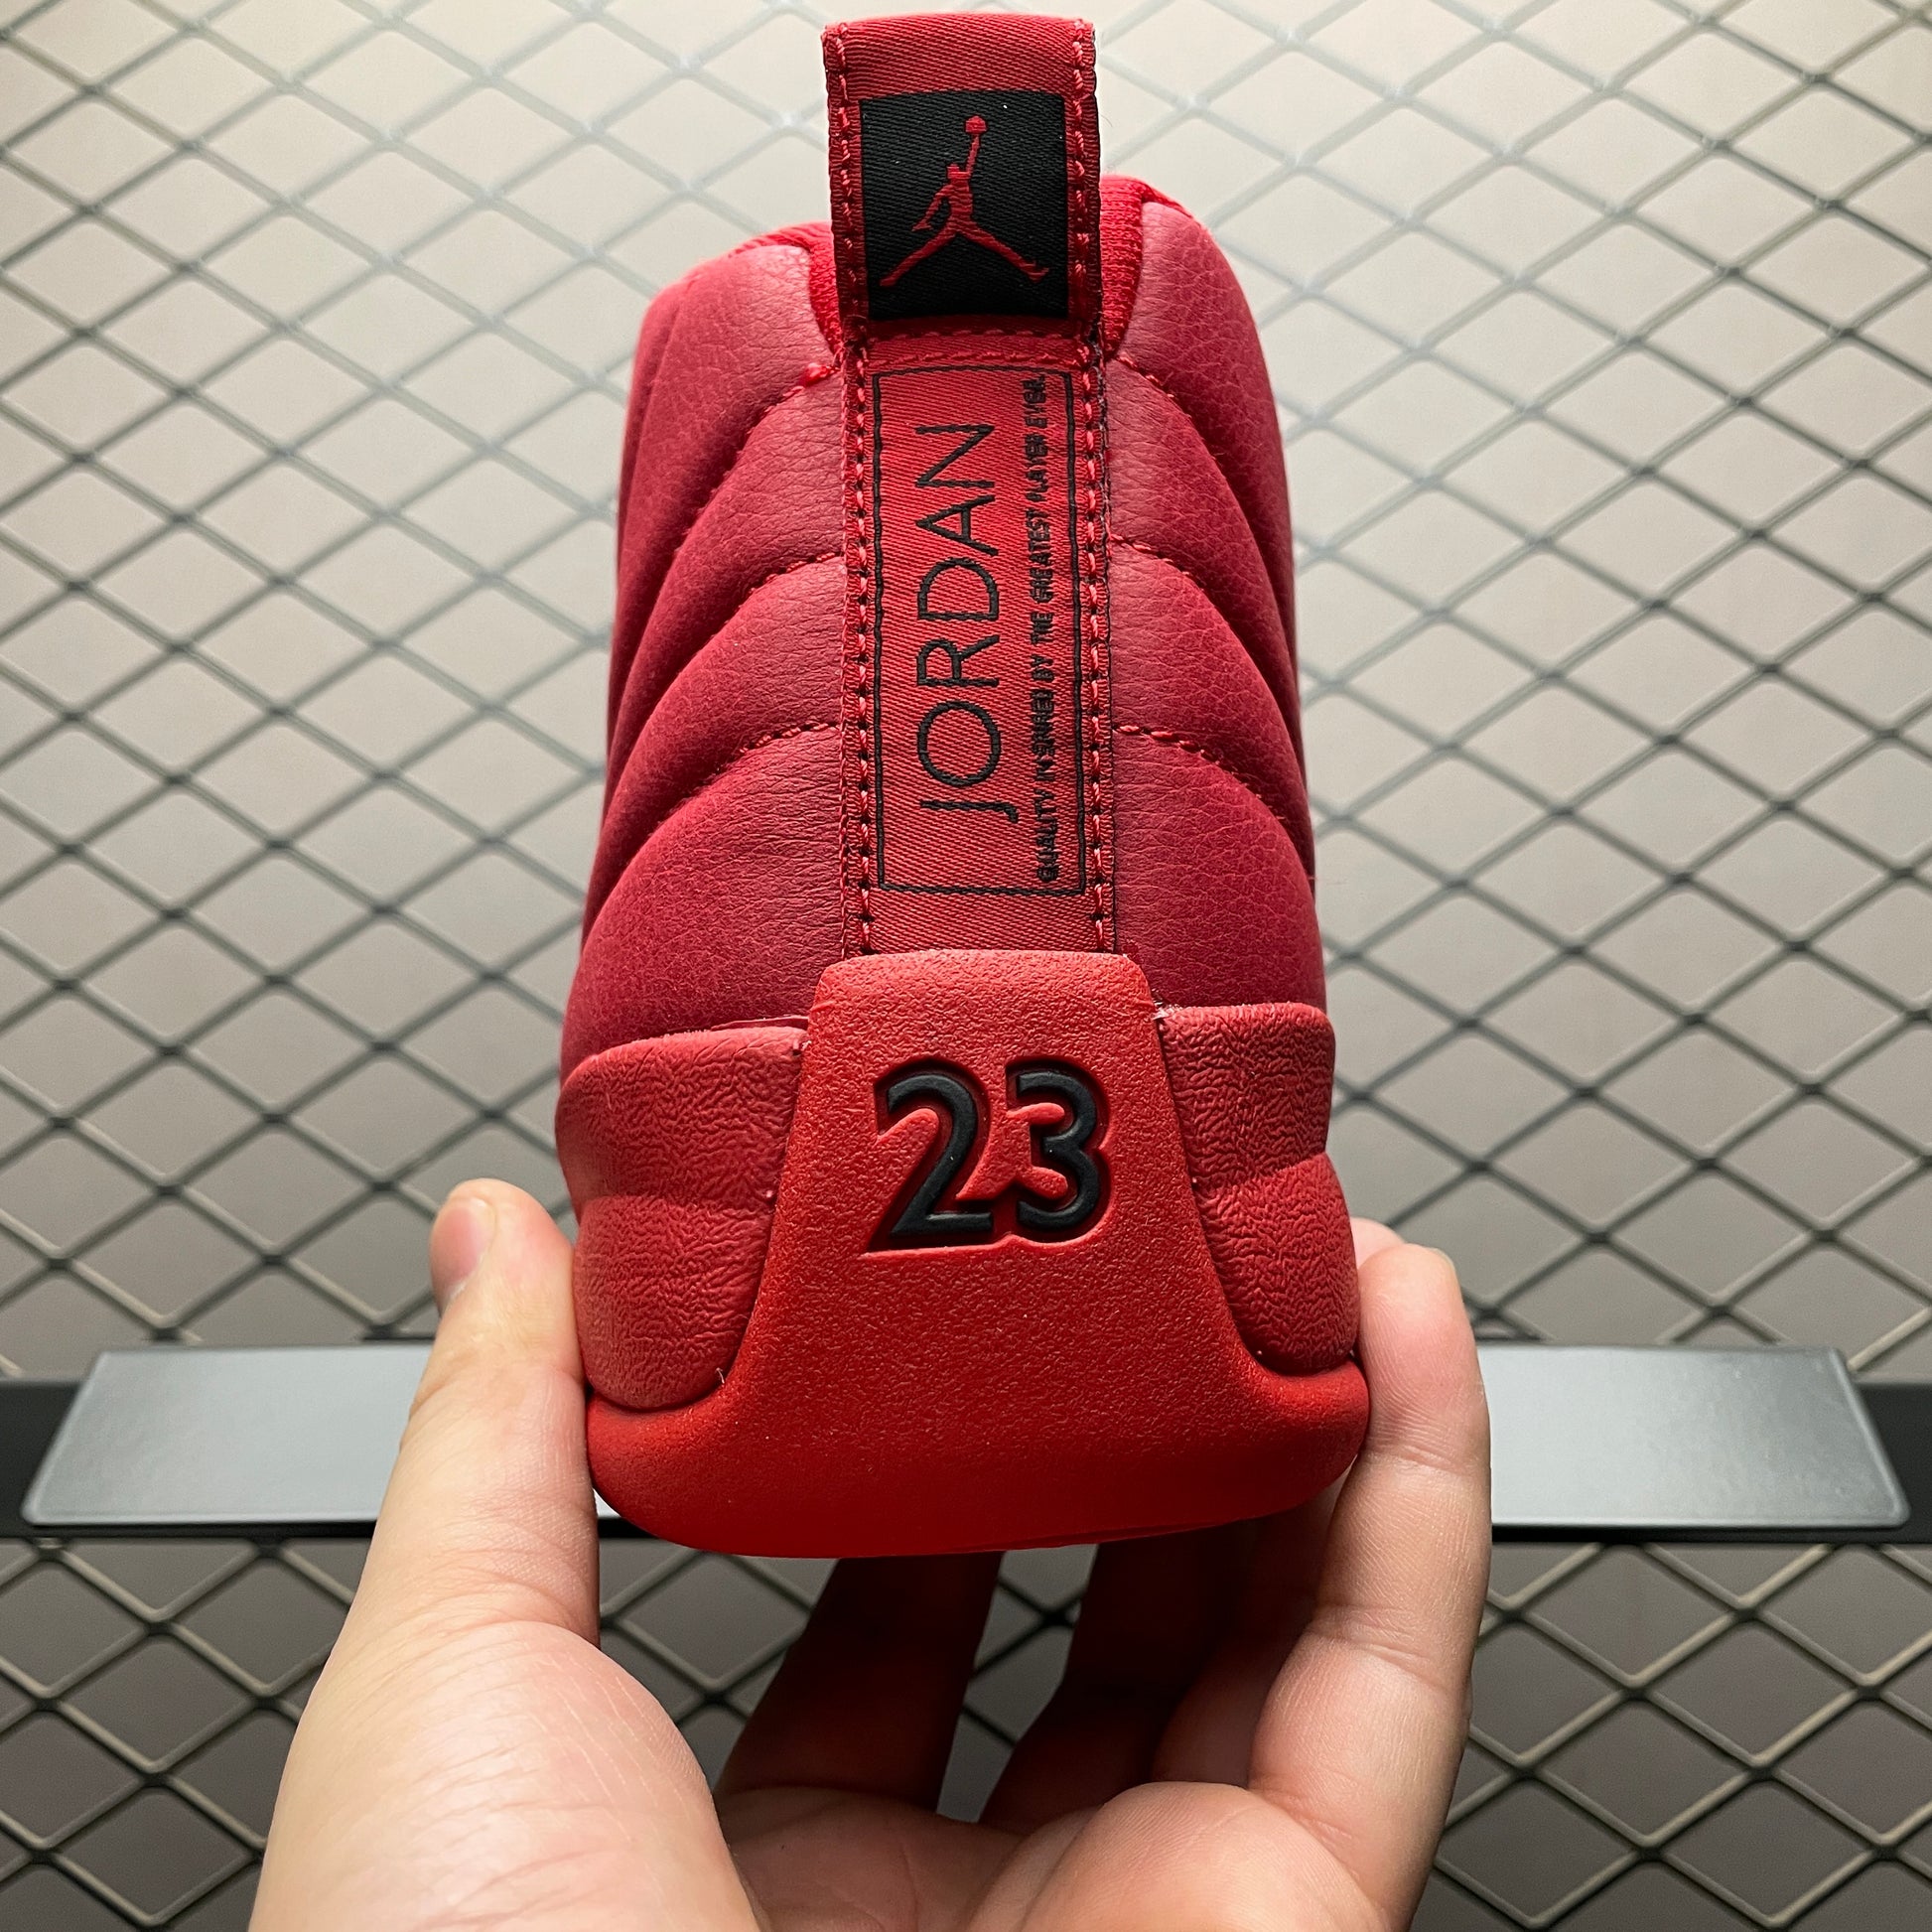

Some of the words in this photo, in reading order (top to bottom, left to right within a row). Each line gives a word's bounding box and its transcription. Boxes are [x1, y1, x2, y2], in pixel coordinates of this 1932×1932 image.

[1026, 507, 1053, 604] GREATEST
[915, 423, 1020, 825] JORDAN
[1030, 611, 1053, 644] THE
[1031, 653, 1054, 683] BY
[1035, 788, 1058, 882] QUALITY
[880, 1064, 1104, 1241] 23
